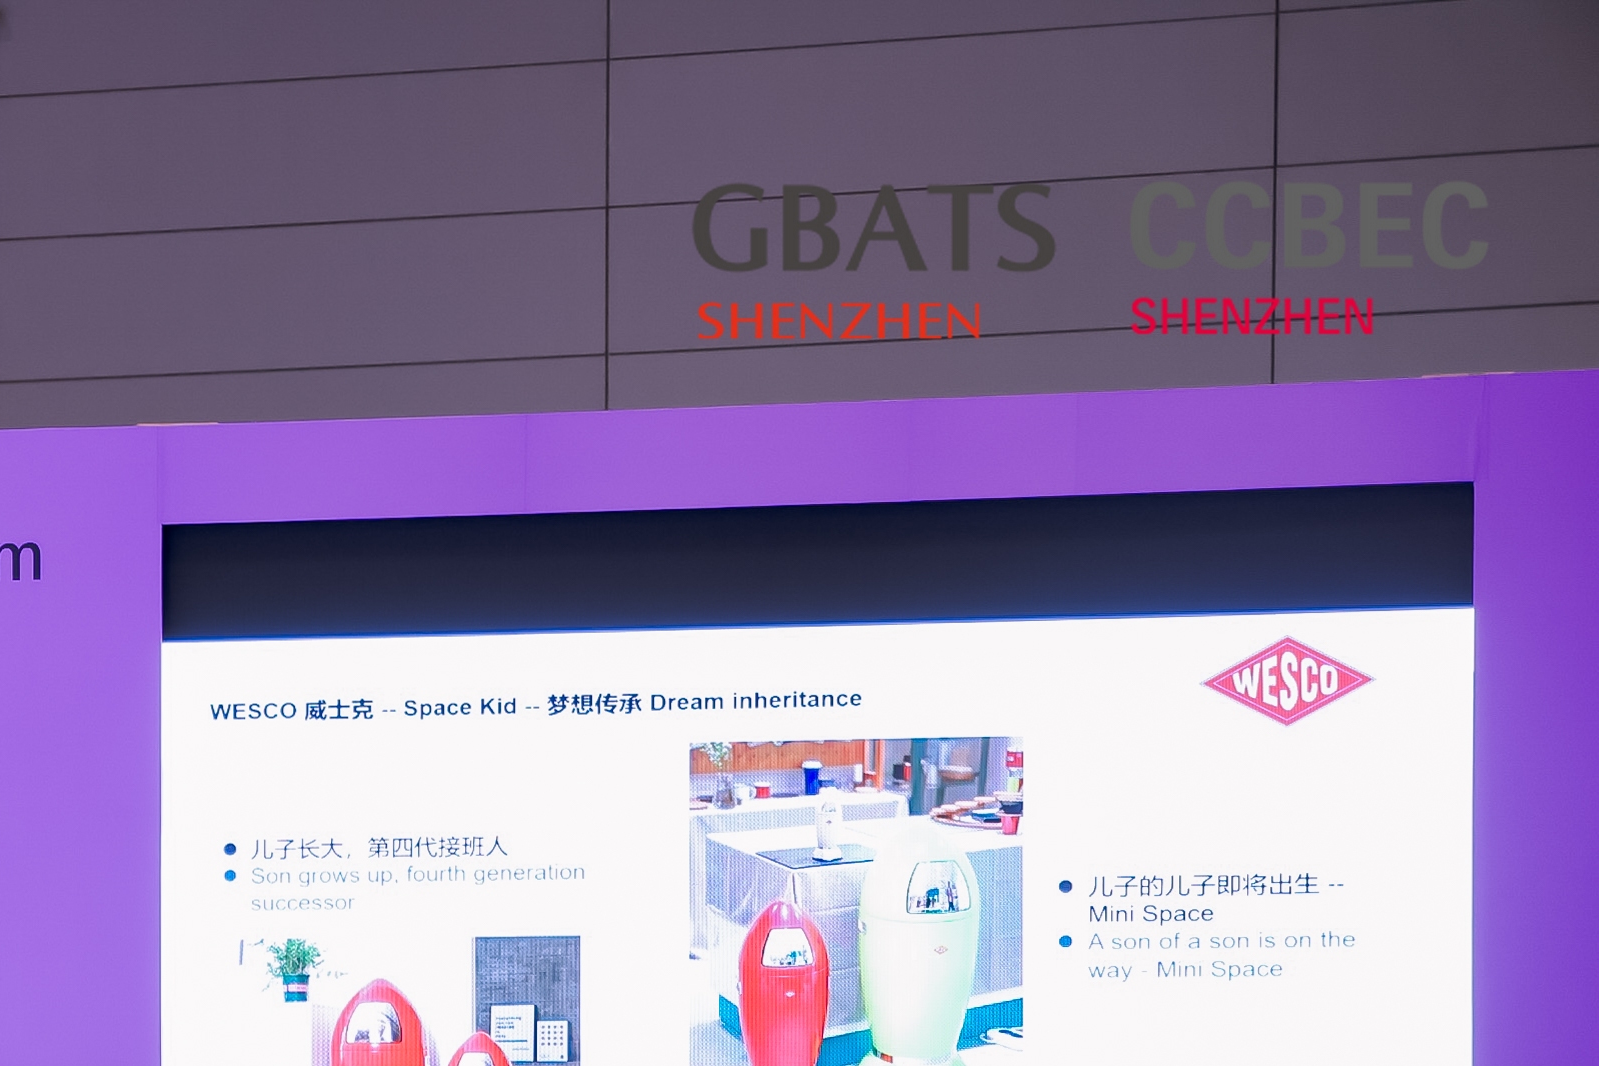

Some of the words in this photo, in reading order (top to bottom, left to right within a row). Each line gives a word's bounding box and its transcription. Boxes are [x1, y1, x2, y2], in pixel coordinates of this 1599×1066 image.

[1232, 651, 1339, 711] WESCO
[210, 702, 297, 721] WESCO
[304, 699, 375, 721] 威士克
[404, 700, 472, 717] Space
[480, 697, 517, 716] Kid
[547, 693, 642, 716] 梦想传承
[651, 693, 724, 712] Dream
[733, 690, 863, 711] inheritance
[251, 835, 509, 861] 儿子长大，第四代接班人
[251, 866, 291, 885] Son
[298, 869, 360, 887] grows
[407, 864, 466, 883] fourth
[473, 863, 586, 886] generation
[1088, 872, 1321, 898] 儿子的儿子即将出生
[251, 896, 356, 912] successor
[1088, 903, 1135, 923] Mini
[1142, 902, 1215, 926] Space
[1088, 932, 1105, 950] A
[1110, 935, 1151, 950] son
[1159, 931, 1180, 949] of
[1187, 936, 1201, 949] a
[1209, 934, 1250, 949] son
[1258, 931, 1277, 949] is
[1283, 935, 1312, 948] on
[1321, 930, 1356, 948] the
[1088, 963, 1133, 983] way
[1156, 960, 1202, 979] Mini
[1211, 960, 1283, 981] Space
